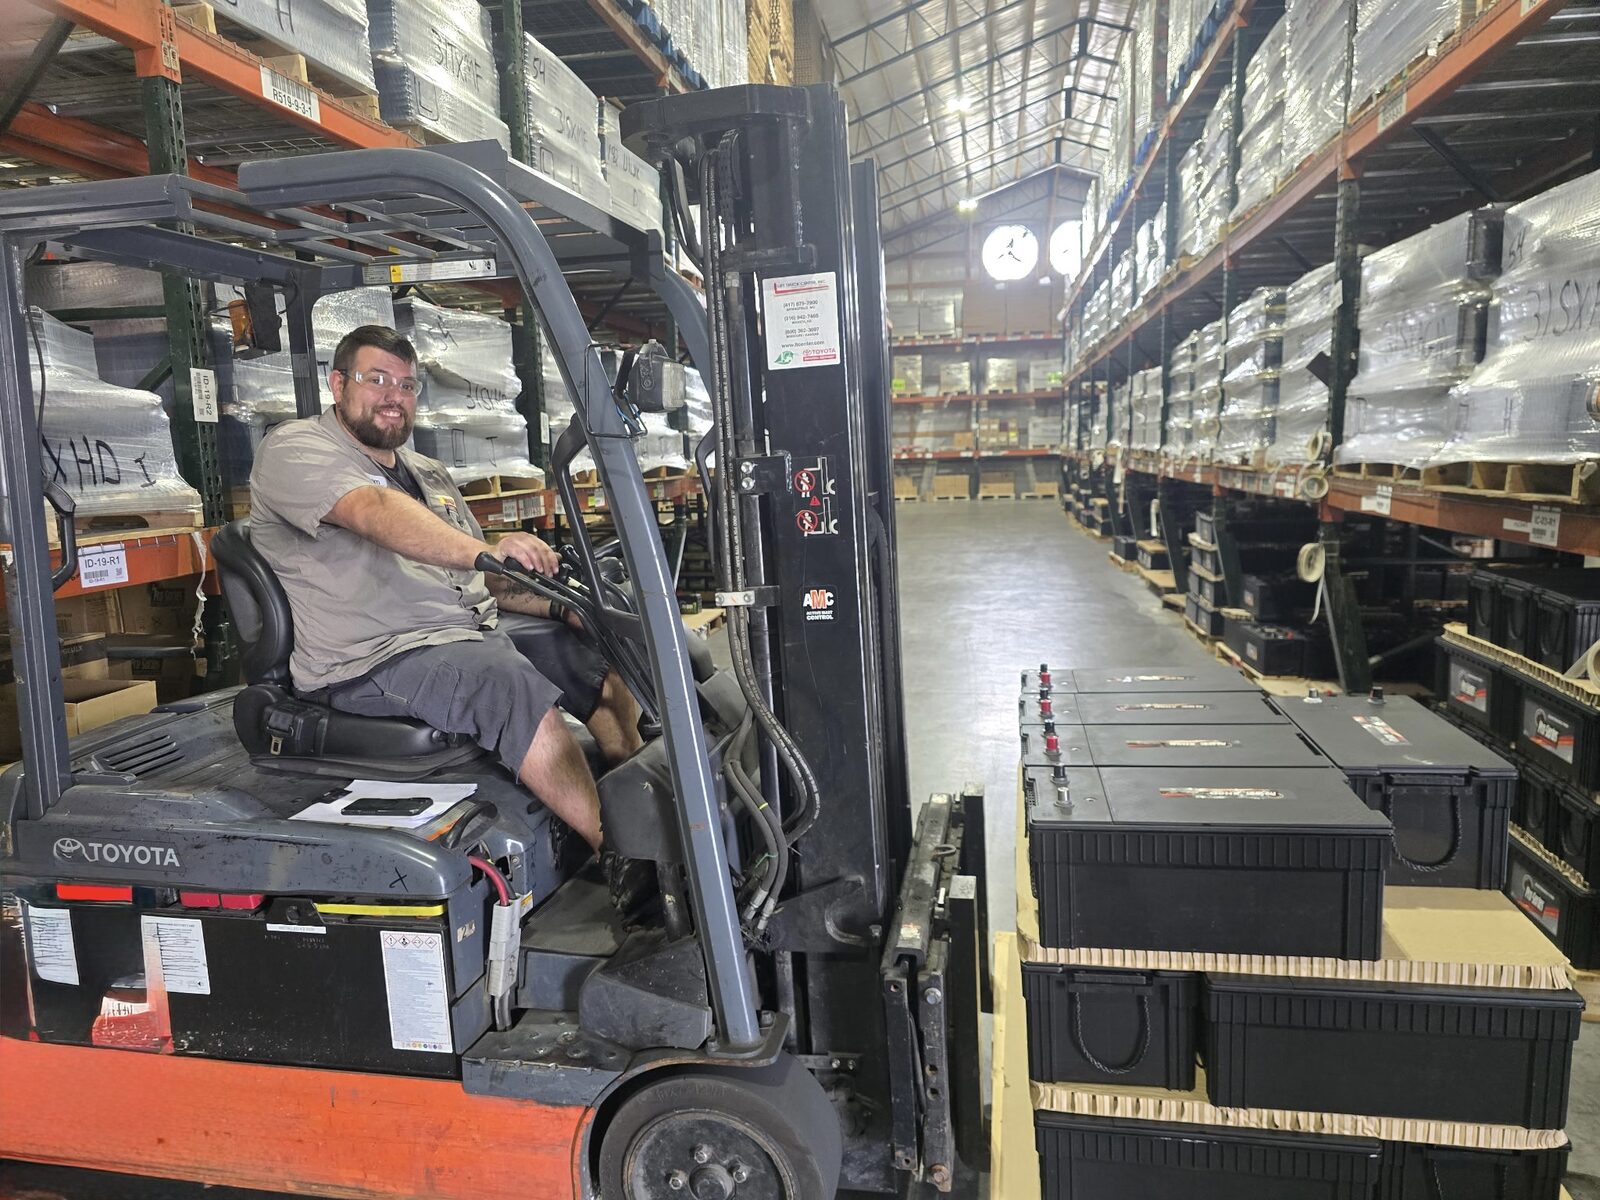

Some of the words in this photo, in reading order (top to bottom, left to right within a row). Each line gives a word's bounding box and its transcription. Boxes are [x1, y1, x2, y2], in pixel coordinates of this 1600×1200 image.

[272, 88, 313, 118] R519-9-3-1
[202, 375, 213, 416] ID-19-R2
[84, 556, 120, 569] ID-19-R1
[803, 589, 834, 609] AMC
[88, 842, 180, 867] TOYOTA
